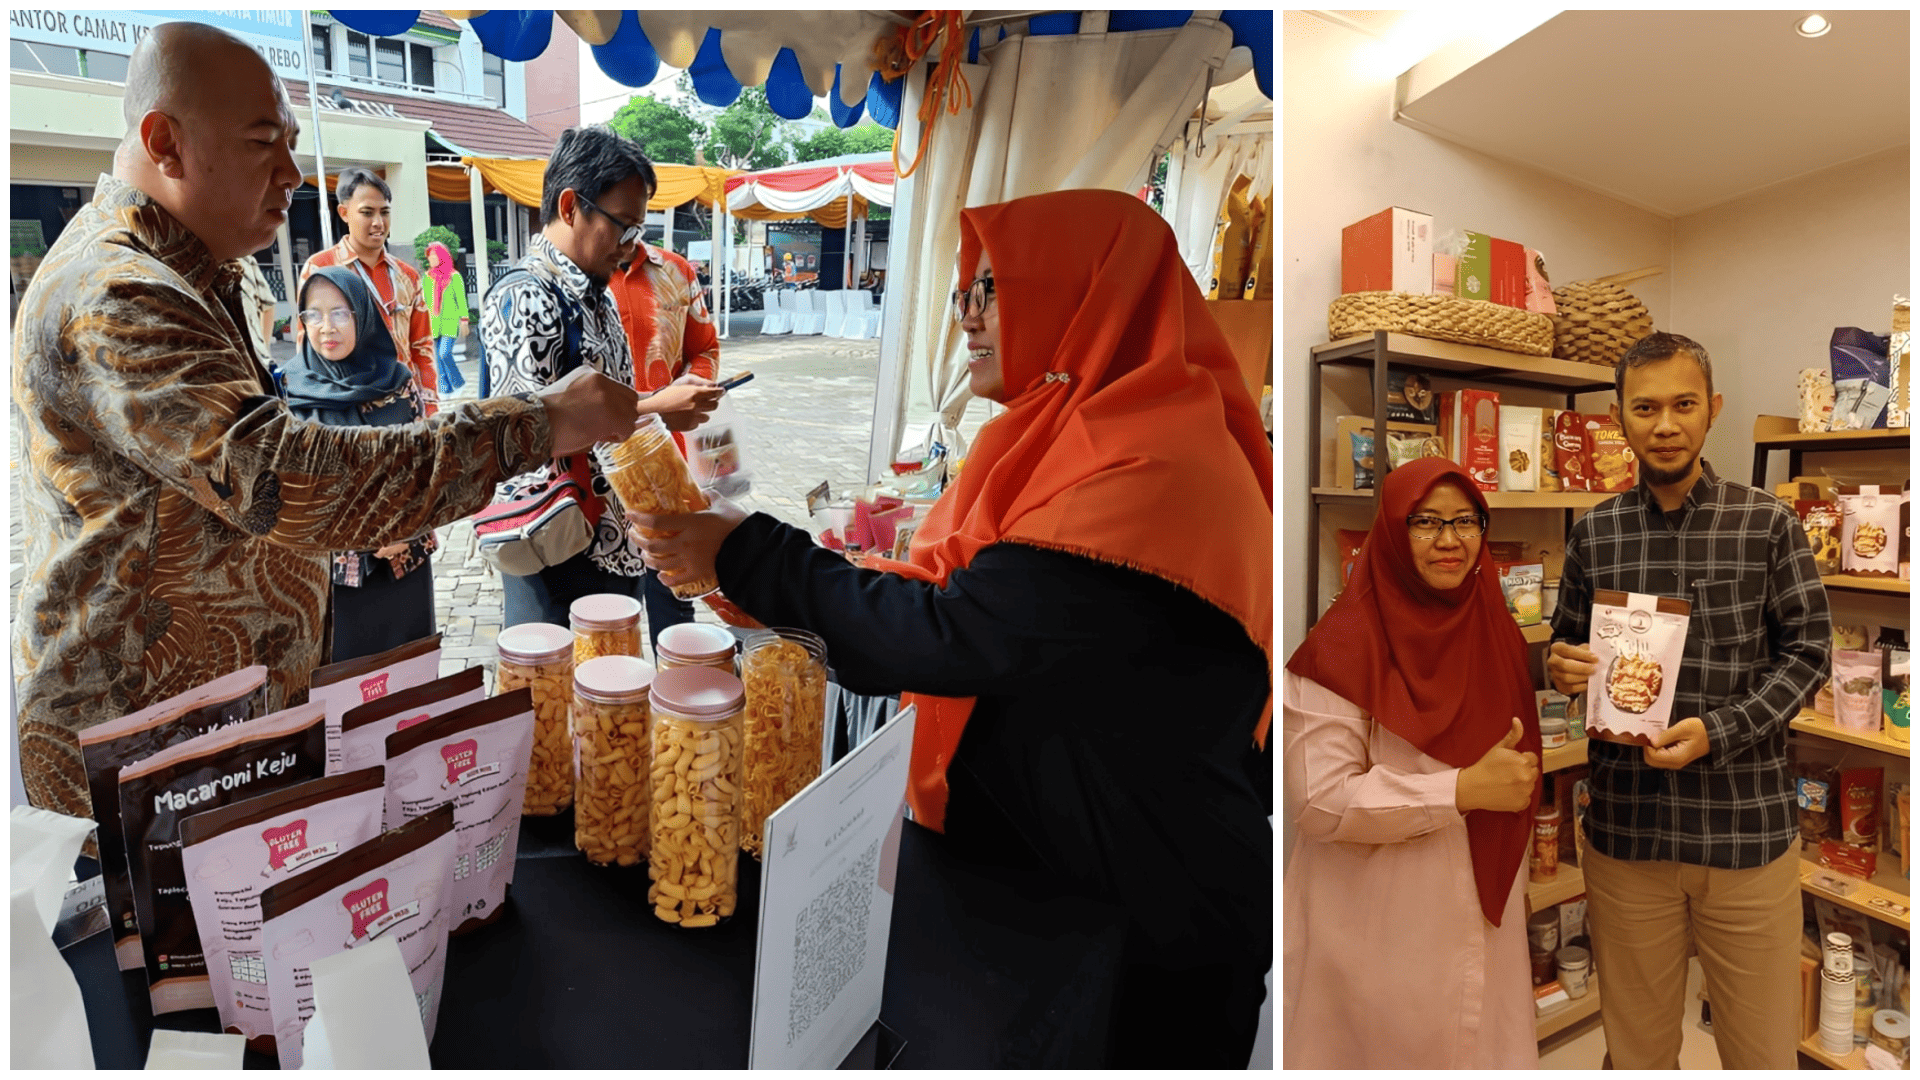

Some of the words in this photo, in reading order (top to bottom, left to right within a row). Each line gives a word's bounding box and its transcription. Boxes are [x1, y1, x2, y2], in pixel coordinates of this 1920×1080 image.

[74, 15, 127, 42] CAMAT
[269, 46, 301, 70] REBO
[154, 763, 251, 814] Macaroni
[256, 751, 297, 779] Keju
[277, 838, 300, 854] FREE
[157, 886, 188, 896] Tapioc
[350, 890, 384, 914] GLUTEN
[359, 901, 383, 921] FREE
